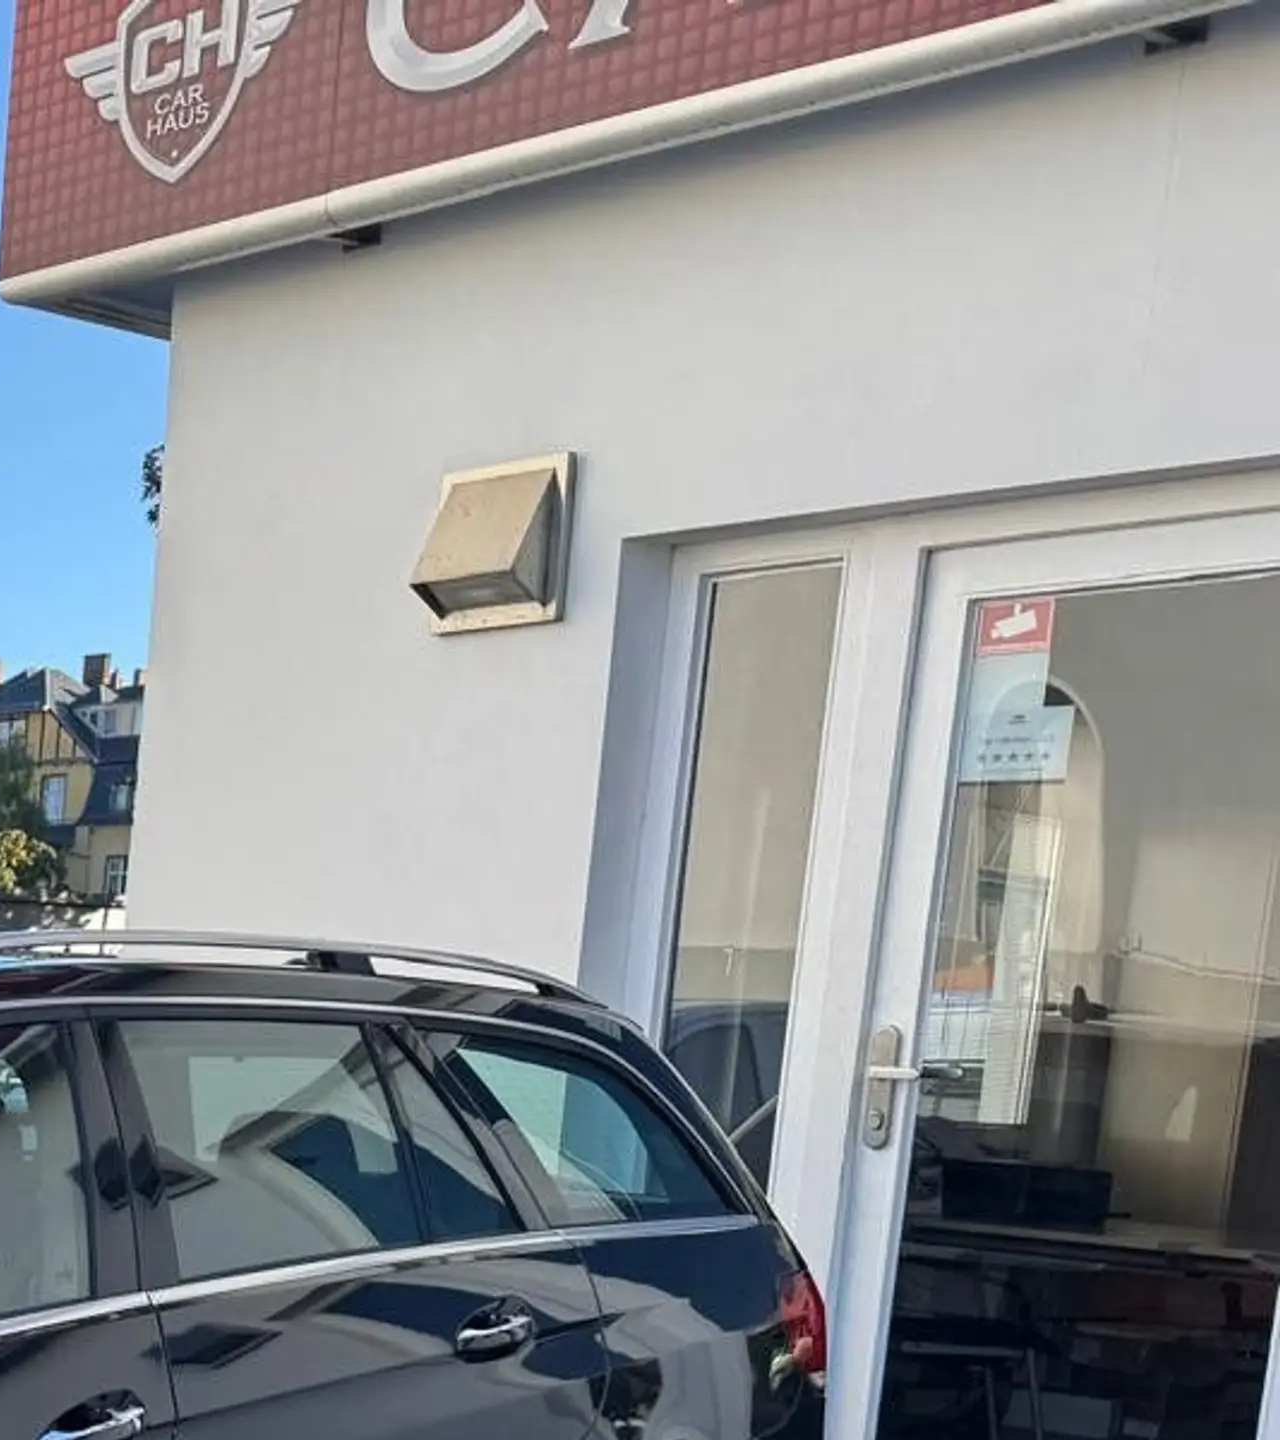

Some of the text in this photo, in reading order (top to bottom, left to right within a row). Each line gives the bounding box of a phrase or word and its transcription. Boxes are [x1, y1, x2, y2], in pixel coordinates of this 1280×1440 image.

[131, 0, 239, 94] CH
[154, 84, 204, 115] CAR
[146, 103, 210, 138] HAUS
